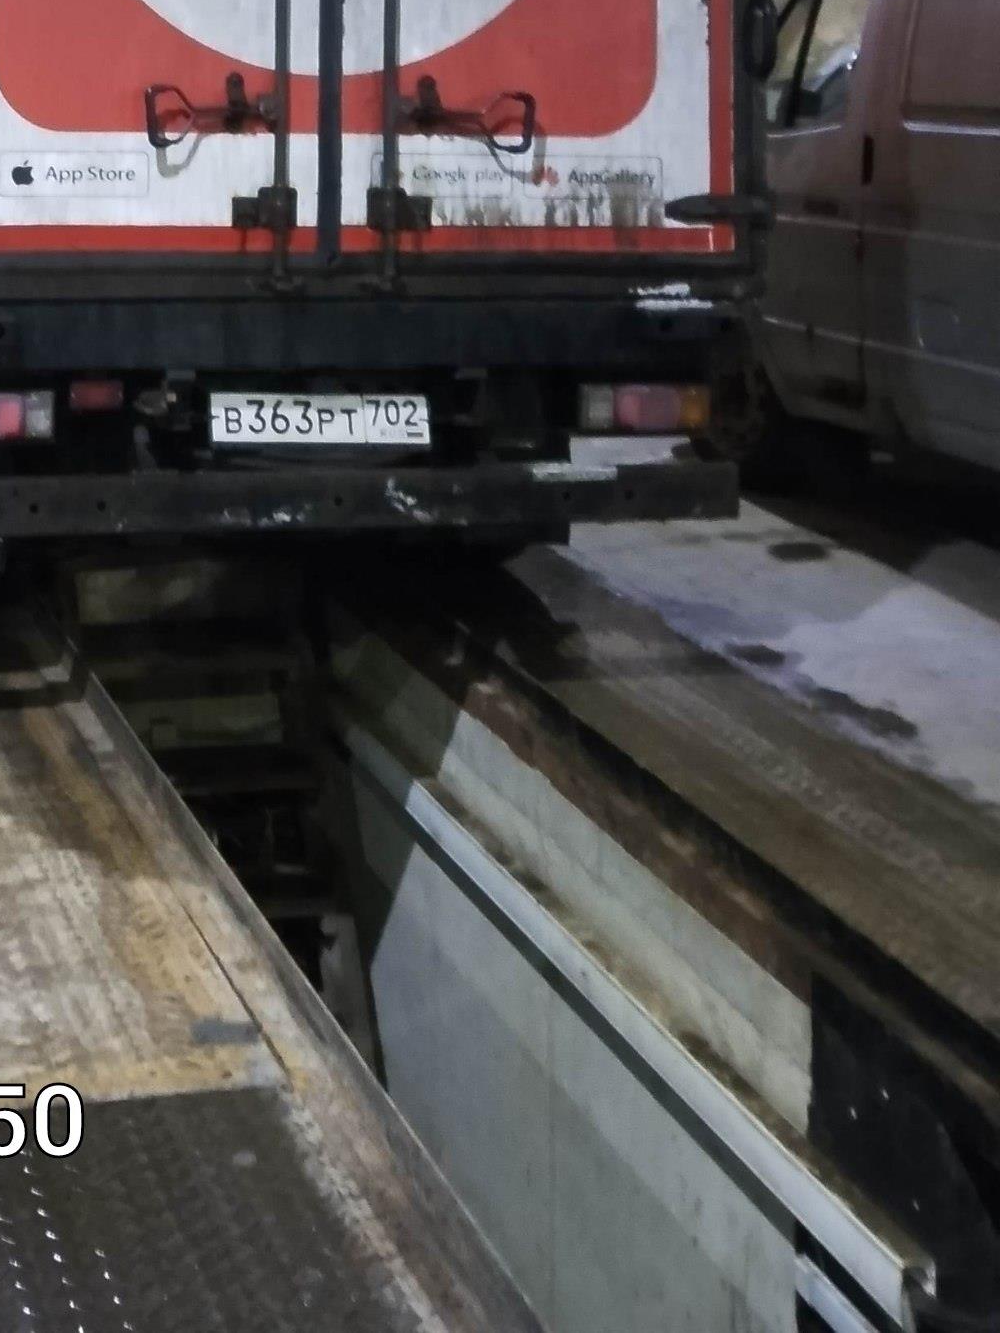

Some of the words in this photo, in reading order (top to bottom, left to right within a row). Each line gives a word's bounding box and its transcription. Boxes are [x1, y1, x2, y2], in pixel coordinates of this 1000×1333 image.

[45, 166, 83, 184] App
[87, 166, 136, 181] Store
[568, 168, 656, 188] AppGallery
[223, 399, 358, 436] В363РТ
[365, 399, 419, 427] 702
